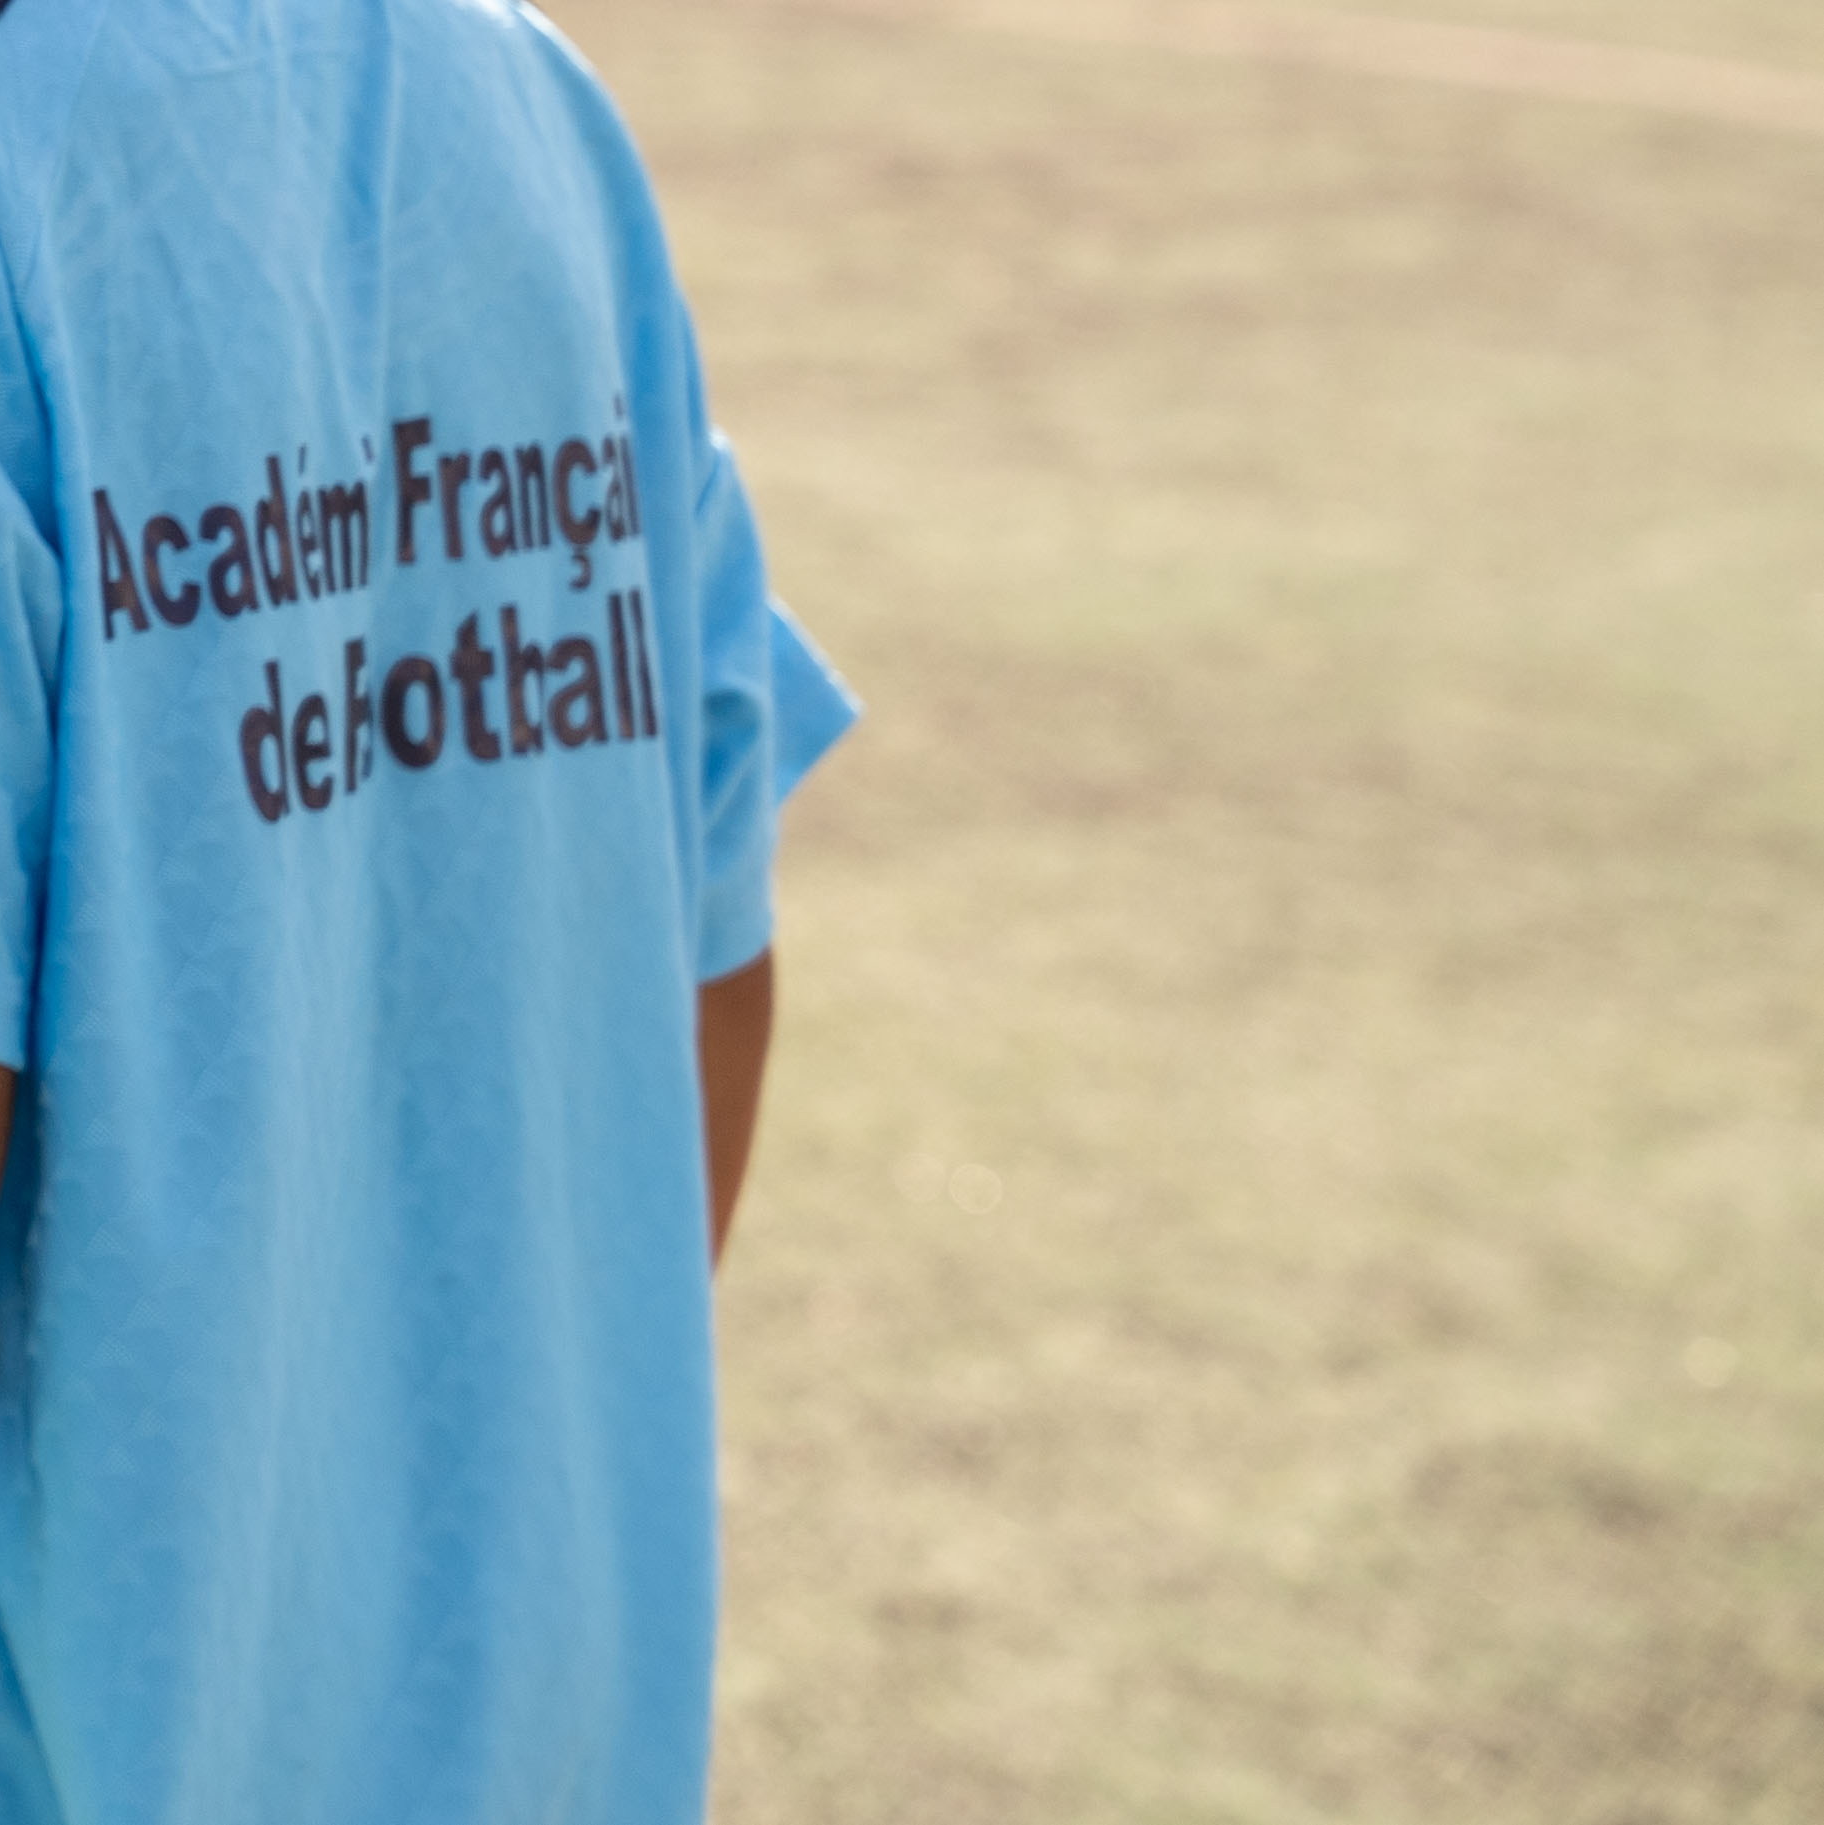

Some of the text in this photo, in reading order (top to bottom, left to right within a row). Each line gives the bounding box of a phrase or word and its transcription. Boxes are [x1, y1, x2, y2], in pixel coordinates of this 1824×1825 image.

[92, 390, 642, 641] Académ Françai
[239, 588, 659, 824] de Fotball
